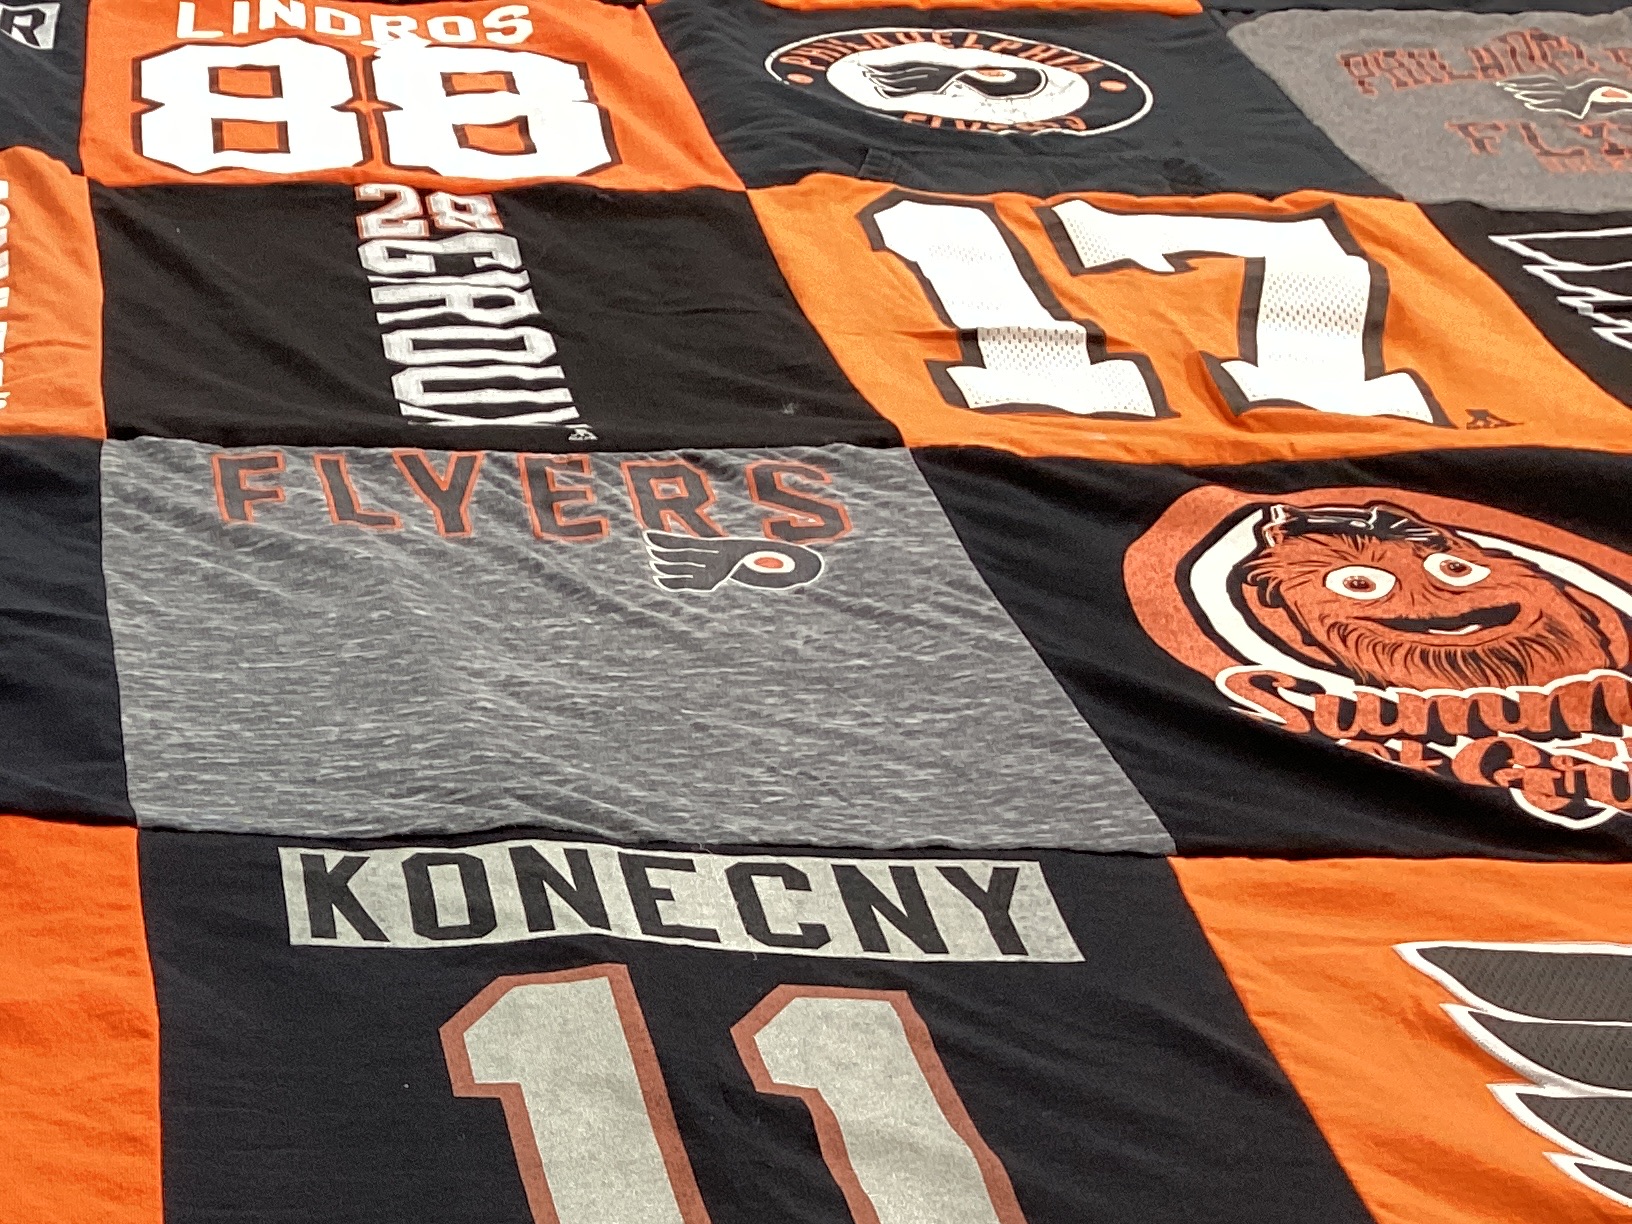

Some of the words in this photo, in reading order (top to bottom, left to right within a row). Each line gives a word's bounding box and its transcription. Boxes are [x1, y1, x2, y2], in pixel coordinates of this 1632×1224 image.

[176, 0, 534, 47] LINDROS
[779, 30, 1105, 75] PHILADELPHIA
[131, 36, 622, 180] 88
[354, 183, 504, 239] 28
[358, 231, 592, 428] GIROUX
[856, 187, 1458, 428] 17
[210, 447, 854, 545] FLYERS
[298, 843, 1031, 957] KONECNY
